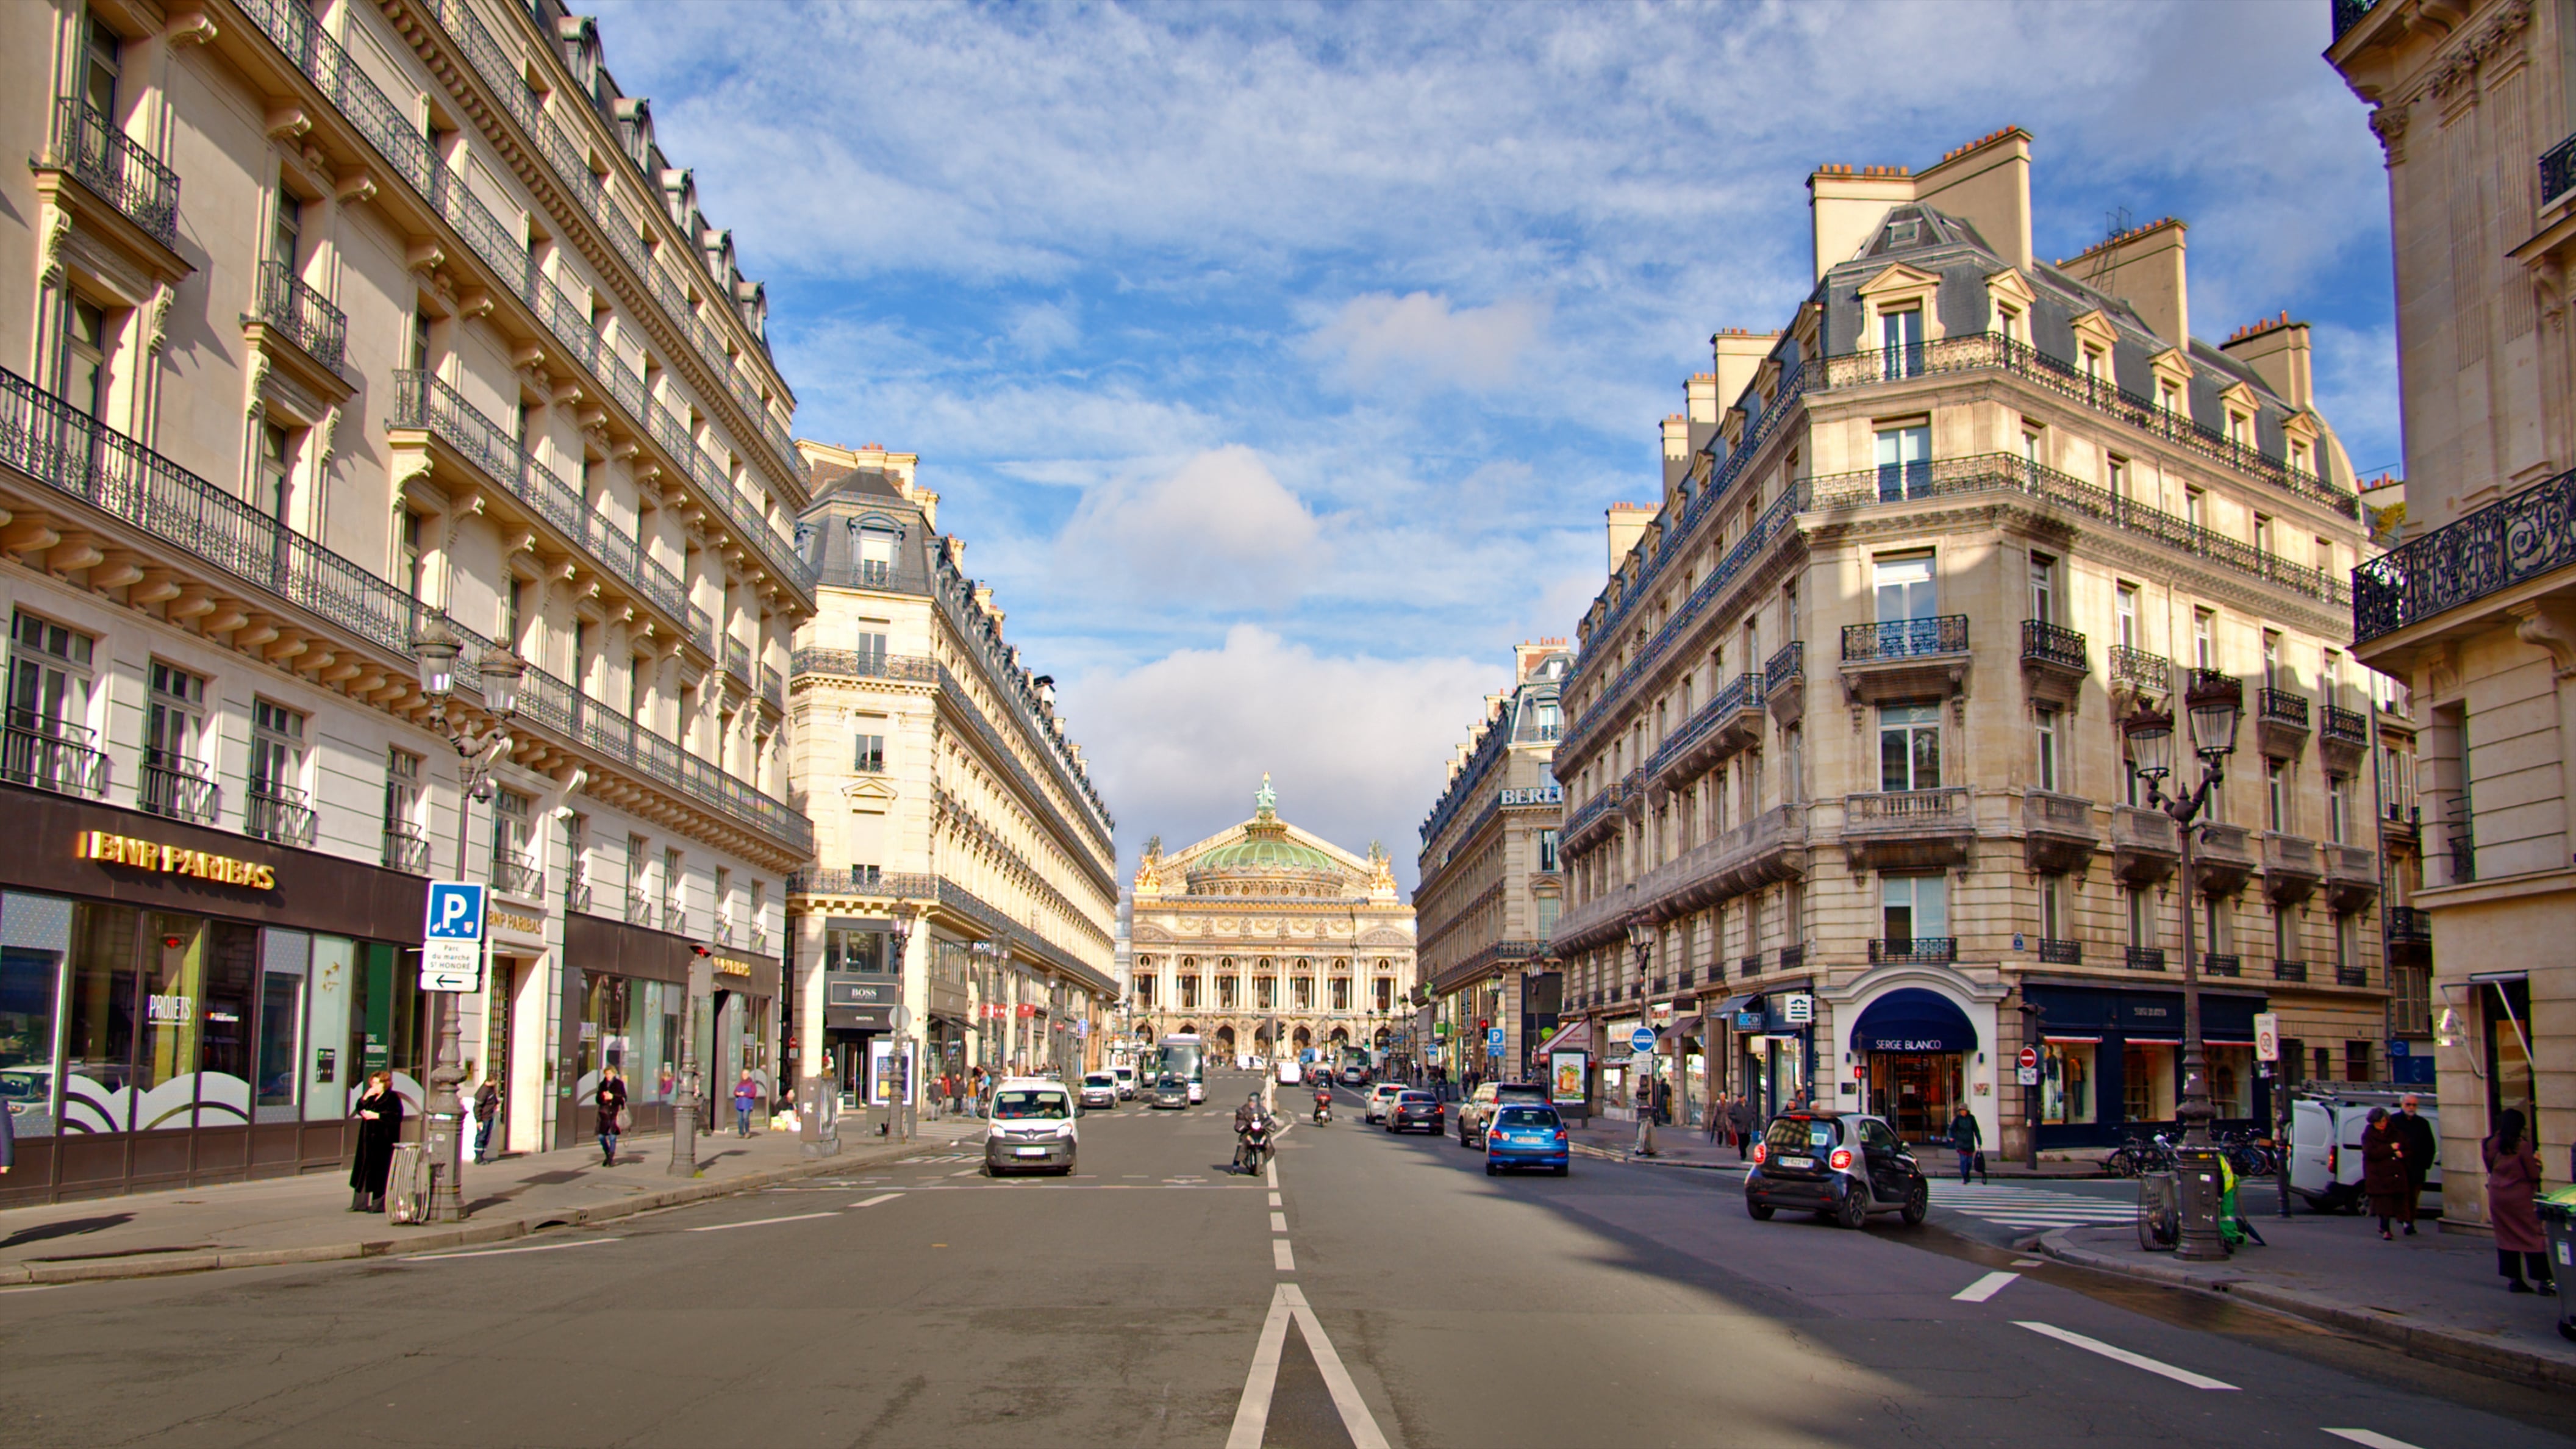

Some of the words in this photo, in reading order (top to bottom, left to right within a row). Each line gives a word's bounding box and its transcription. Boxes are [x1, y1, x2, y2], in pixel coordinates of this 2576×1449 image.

[90, 831, 160, 871] BNP
[161, 845, 275, 890] PARIBAS
[442, 893, 467, 929] P
[488, 911, 506, 928] BNP
[507, 914, 542, 934] PARIBAS
[973, 942, 990, 950] BOS
[149, 994, 191, 1020] PROJETS
[1492, 1031, 1501, 1042] P
[1876, 1039, 1902, 1050] SERGE
[1905, 1039, 1942, 1050] BLANCO
